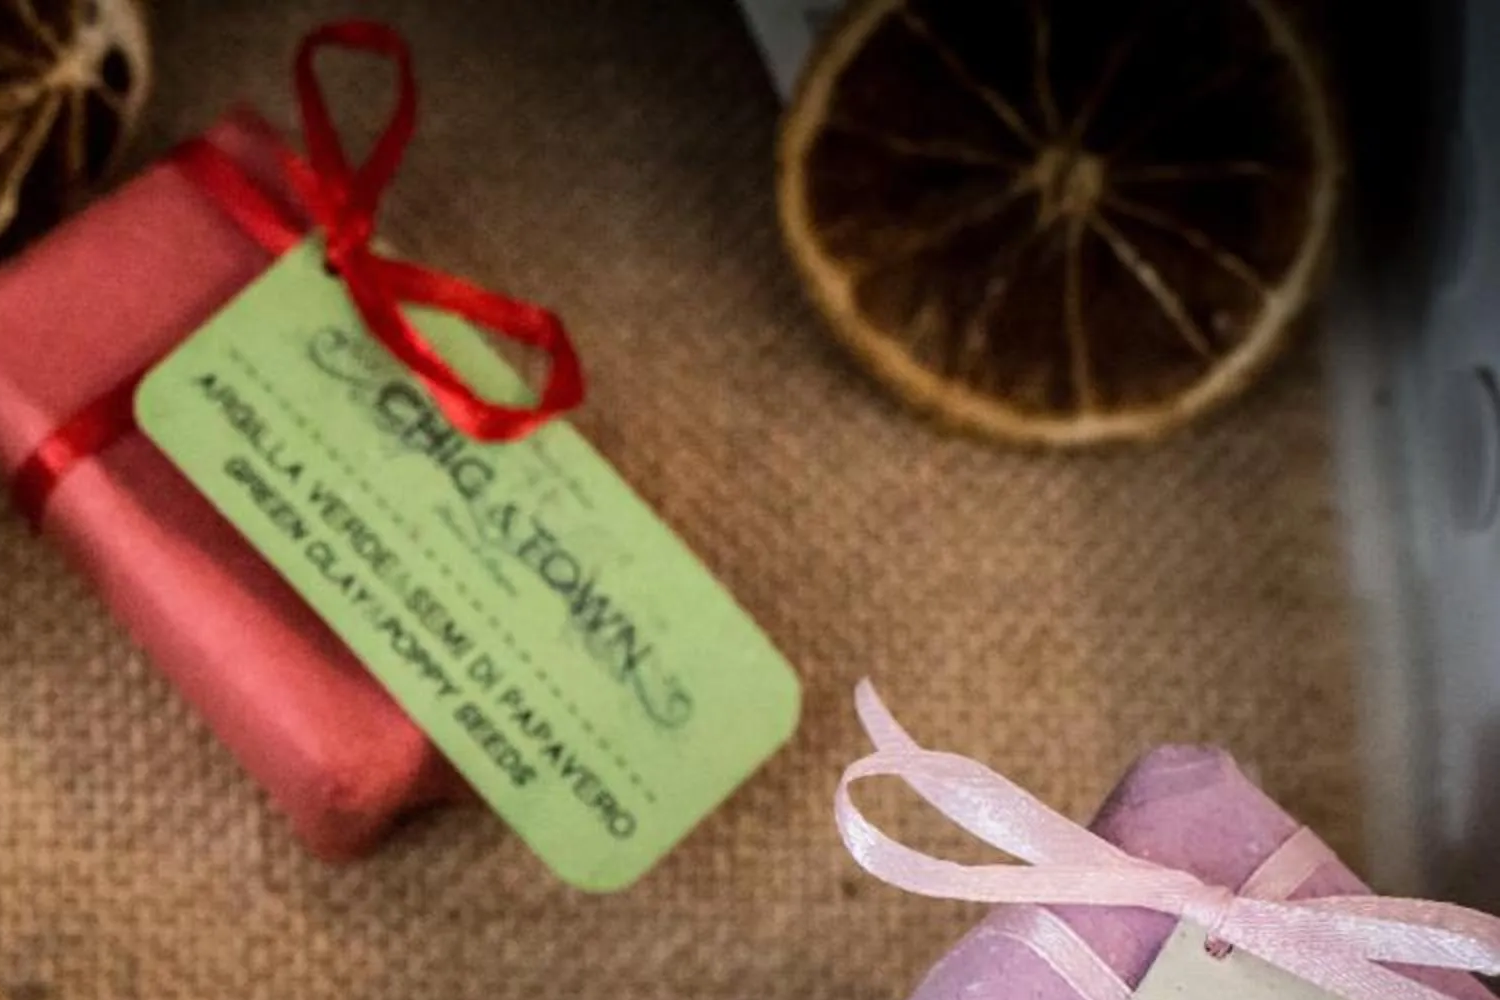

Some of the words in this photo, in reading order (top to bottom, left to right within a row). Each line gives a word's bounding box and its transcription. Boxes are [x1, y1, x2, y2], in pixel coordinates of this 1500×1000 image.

[190, 373, 305, 482] ARGILLA
[308, 480, 402, 582] VERDE
[404, 586, 477, 660] SEMI
[467, 652, 500, 690] DI
[497, 684, 637, 839] PAPAVERO
[223, 456, 311, 542] GREEN
[304, 540, 372, 602] CLAY
[376, 614, 462, 699] POPPY
